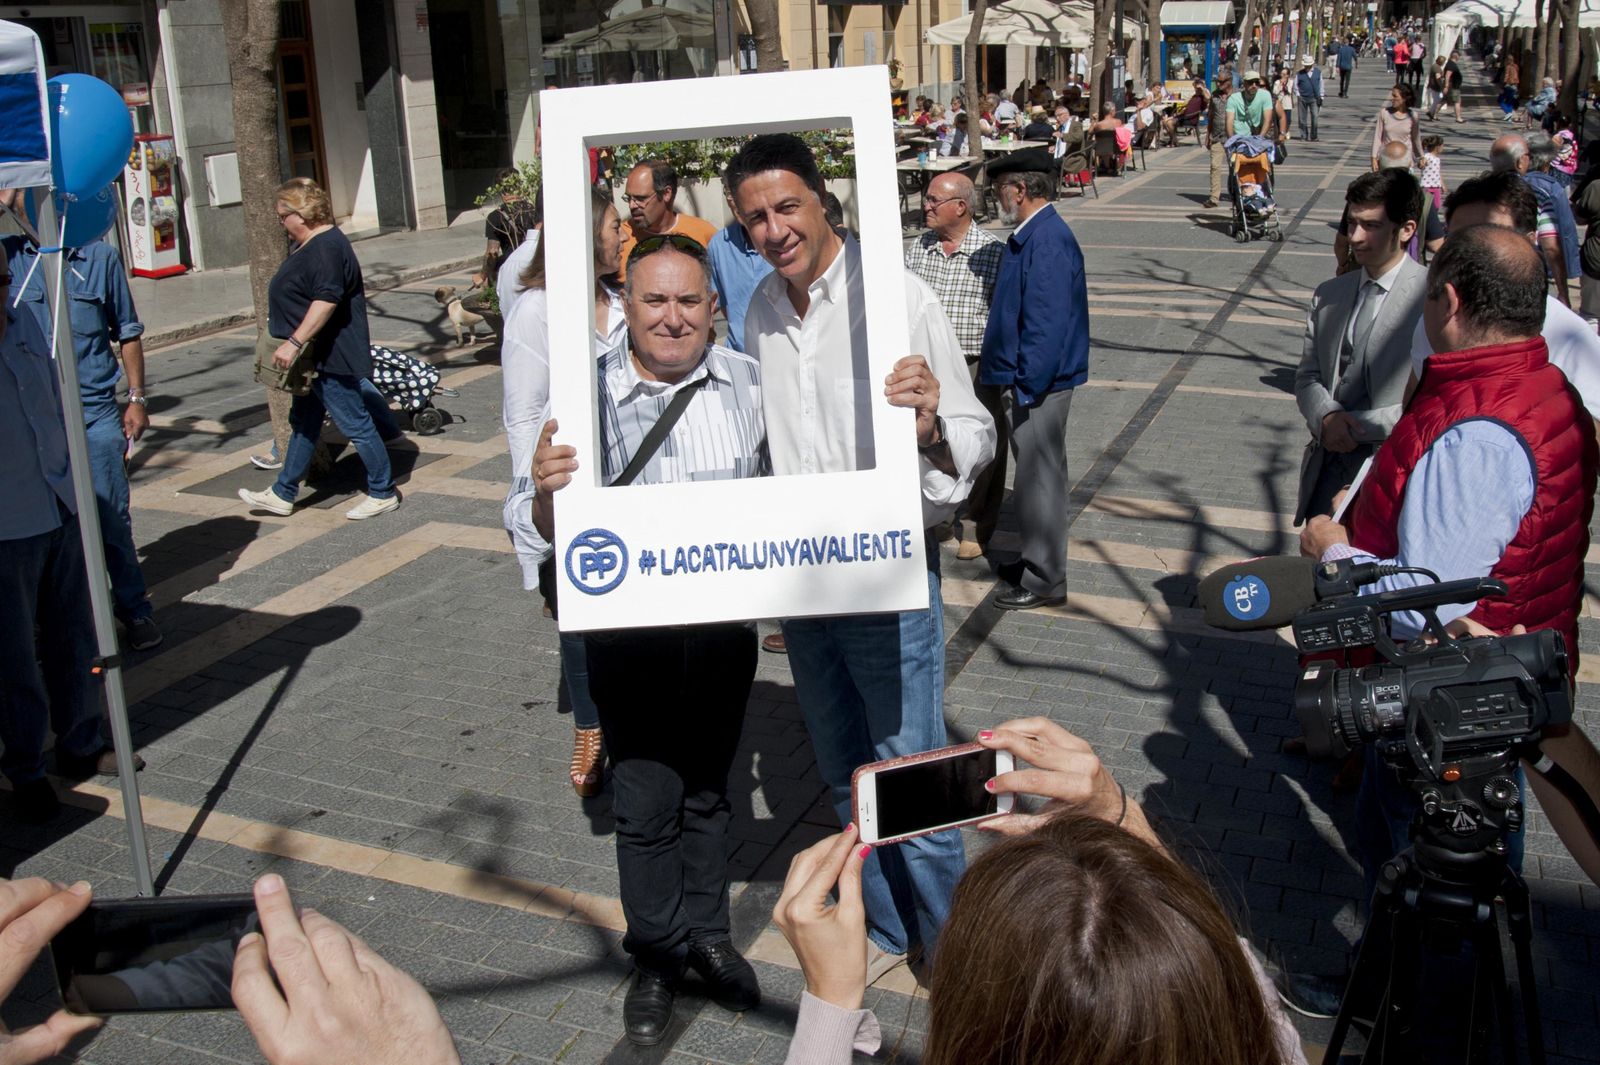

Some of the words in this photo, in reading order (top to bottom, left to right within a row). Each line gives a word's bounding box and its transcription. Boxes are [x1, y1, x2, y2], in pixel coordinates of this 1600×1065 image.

[638, 529, 912, 576] #LACATALUNYAVALIENTE
[1234, 586, 1252, 612] CB
[1249, 582, 1259, 597] TV
[1375, 684, 1401, 694] 3CCD
